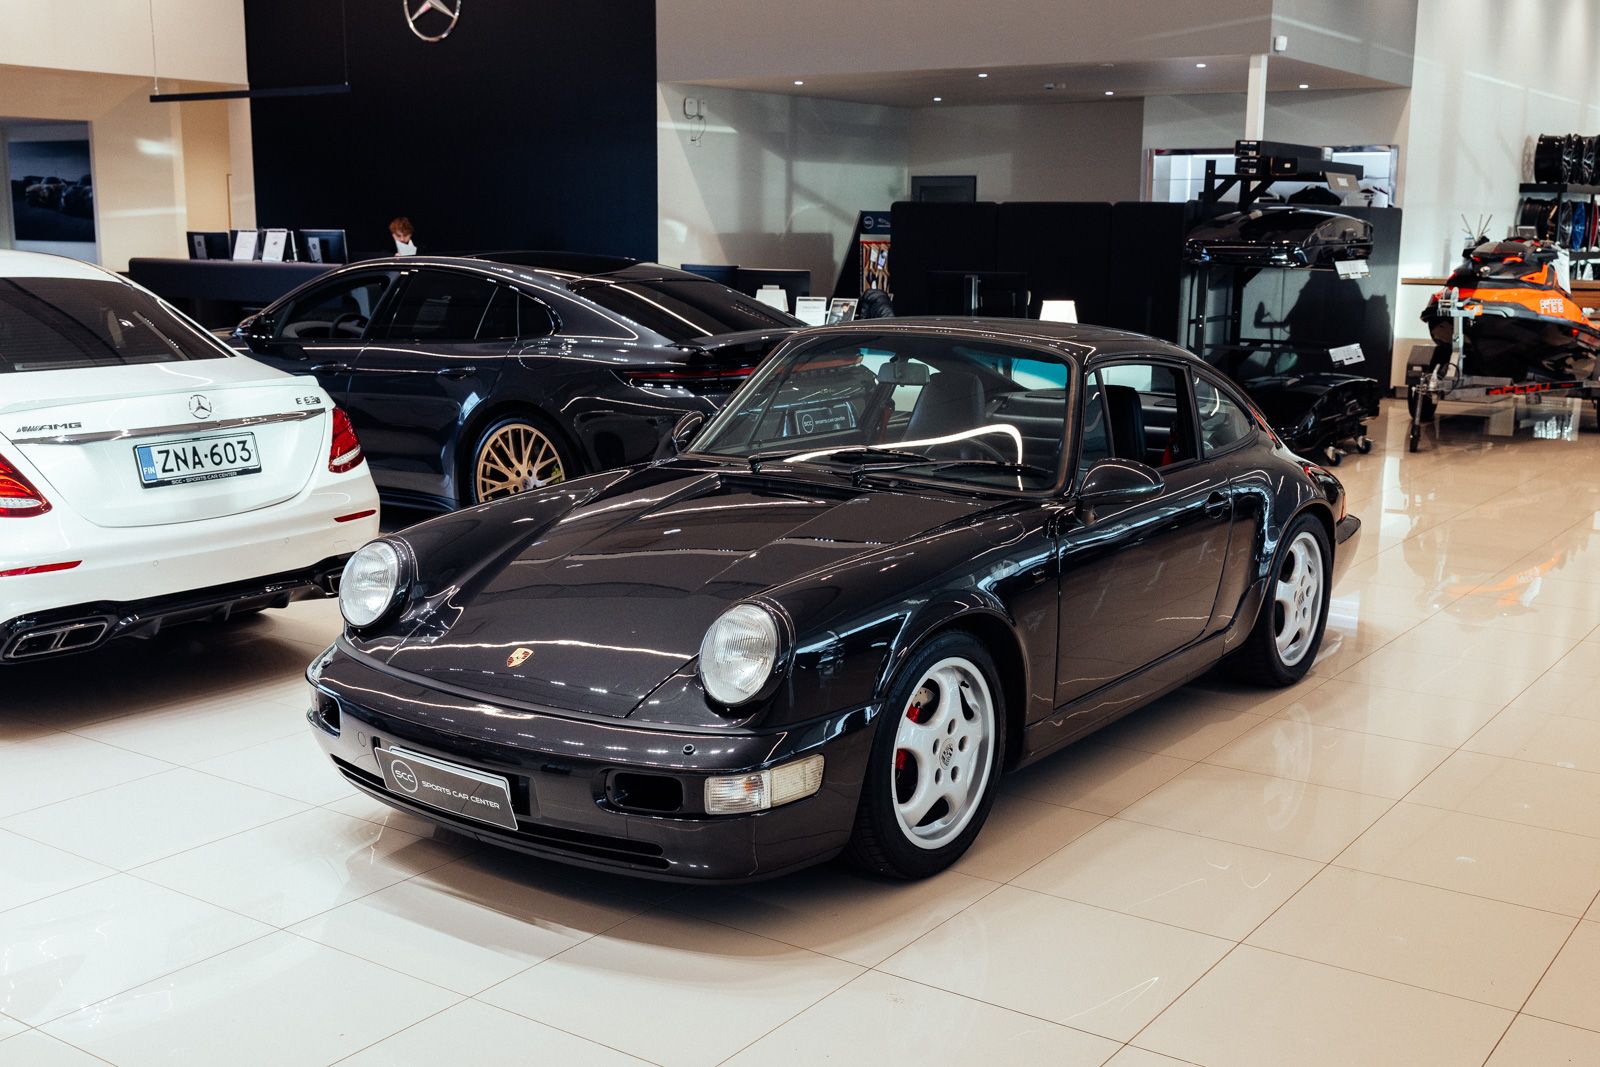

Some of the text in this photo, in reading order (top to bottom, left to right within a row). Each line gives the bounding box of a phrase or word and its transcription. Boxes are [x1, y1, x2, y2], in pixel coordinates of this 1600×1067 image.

[39, 422, 82, 431] AMG
[157, 440, 252, 473] ZNA-603
[143, 466, 156, 475] FIN
[218, 471, 237, 479] CENTER
[395, 770, 415, 783] SCC
[421, 780, 501, 809] SPORTS CAR CENTER
